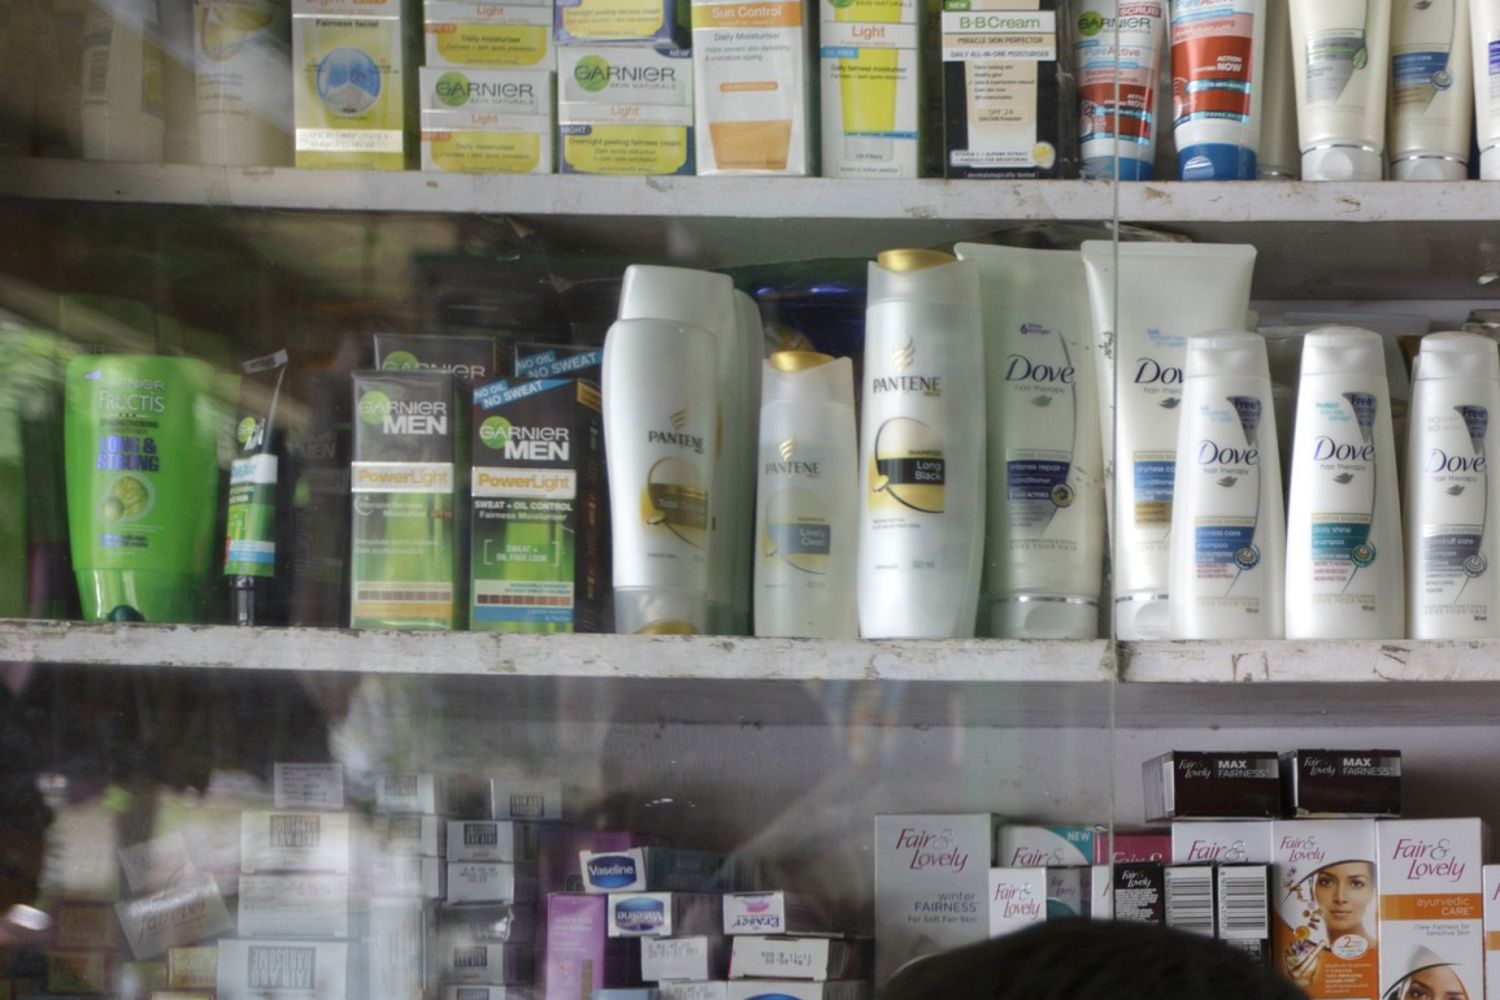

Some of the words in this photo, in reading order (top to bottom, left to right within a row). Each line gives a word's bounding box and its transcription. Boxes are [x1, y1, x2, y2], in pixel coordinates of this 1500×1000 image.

[711, 5, 742, 18] Sun
[743, 5, 783, 18] Control
[713, 32, 735, 42] Daily
[851, 25, 886, 40] Light
[957, 37, 988, 45] MIRACLE
[988, 37, 1004, 45] SKIN
[1004, 36, 1044, 45] PERFECTOR
[573, 65, 676, 83] GARNIER
[1216, 62, 1243, 73] NOW
[434, 81, 535, 98] GARNIER
[610, 104, 640, 117] Light
[1005, 353, 1076, 384] Dove
[872, 376, 943, 395] PANTENE
[482, 394, 502, 408] NO
[502, 380, 544, 401] SWEAT
[358, 401, 448, 416] GARNIER
[382, 415, 448, 435] MEN
[479, 425, 570, 440] GARNIER
[648, 431, 704, 449] PANTENE
[504, 441, 570, 461] MEN
[1198, 439, 1258, 466] Dove
[1313, 436, 1375, 462] Dove
[915, 460, 943, 472] Long
[1425, 448, 1487, 473] Dove
[764, 461, 822, 475] PANTENE
[478, 472, 571, 492] PowerLight
[914, 470, 943, 482] Black
[474, 500, 505, 510] SWEAT
[513, 501, 529, 510] OIL
[530, 501, 573, 512] CONTROL
[1218, 760, 1247, 770] MAX
[1342, 757, 1372, 768] MAX
[1217, 769, 1267, 778] FAIRNESS
[1342, 766, 1392, 776] FAIRNESS
[1066, 831, 1091, 841] NEW
[1391, 837, 1432, 860] Fair
[909, 847, 969, 872] Lovely
[588, 863, 635, 876] Vaseline
[1406, 855, 1468, 882] Lovely
[914, 901, 977, 913] FAIRNESS
[1416, 896, 1471, 909] ayurvedic
[1441, 906, 1473, 916] CARE
